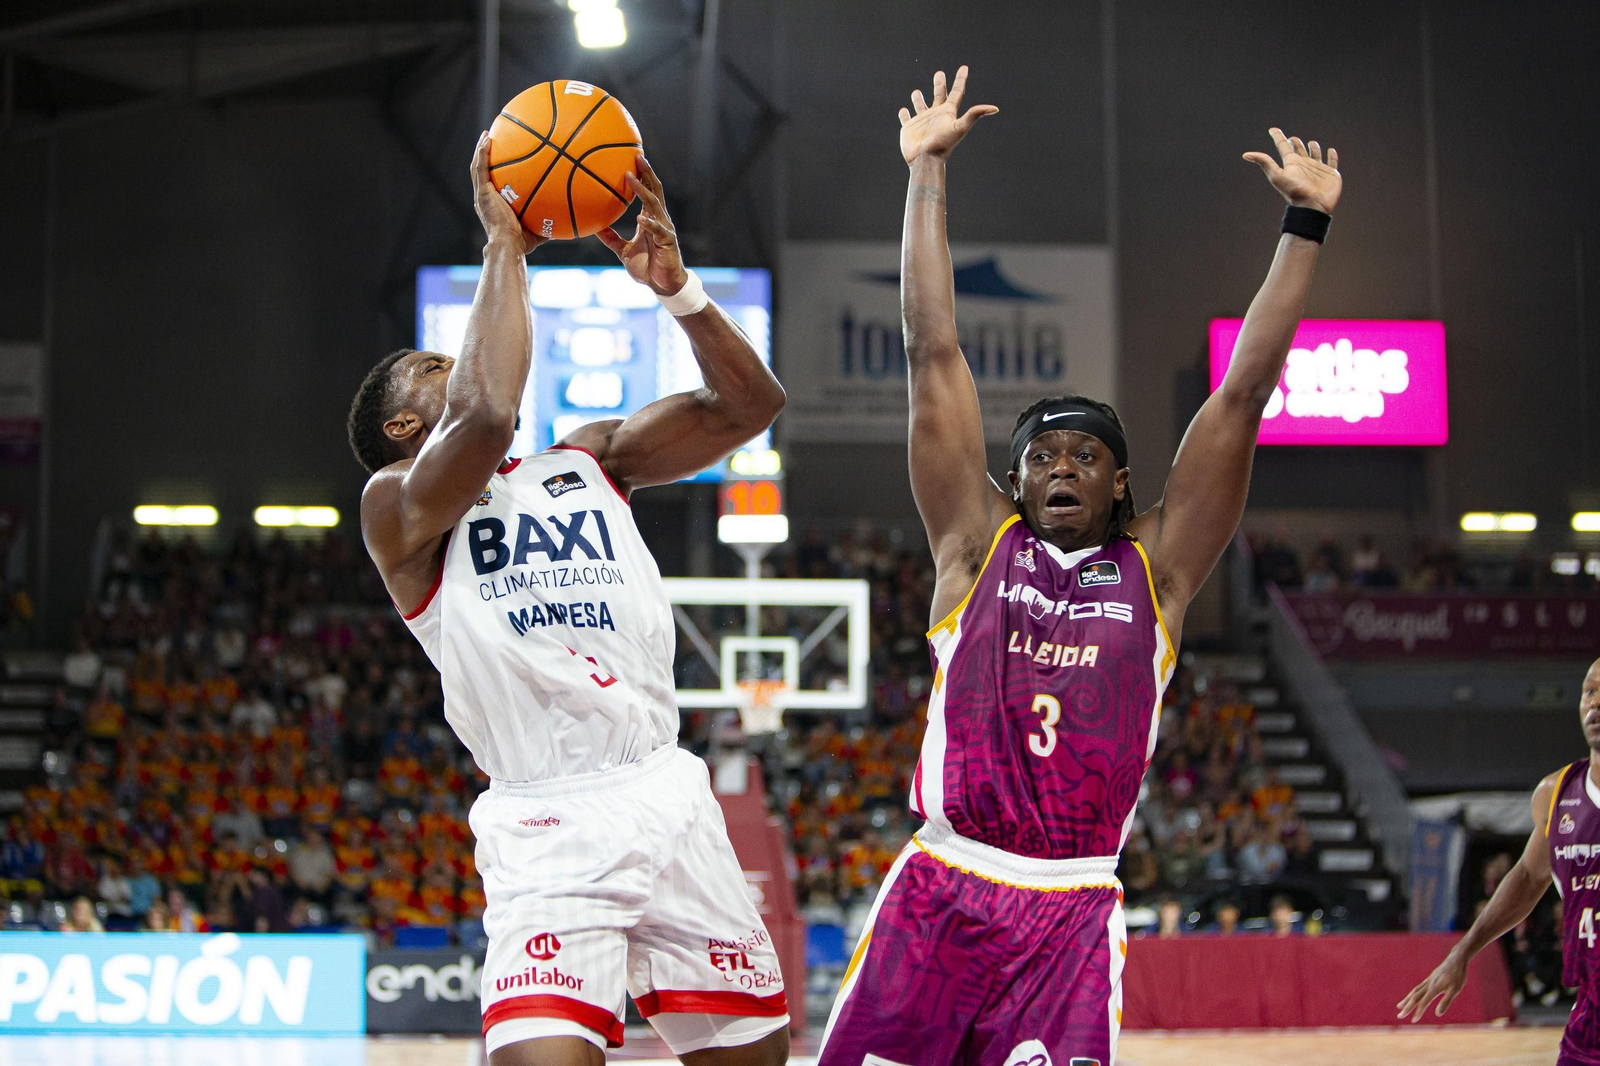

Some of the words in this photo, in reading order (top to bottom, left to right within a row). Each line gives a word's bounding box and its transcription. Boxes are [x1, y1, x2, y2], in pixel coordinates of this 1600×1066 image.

[552, 481, 584, 496] endesa
[726, 480, 782, 516] 10
[466, 509, 616, 576] BAXI
[479, 563, 625, 602] CLIMATIZACIÓN
[1083, 575, 1117, 584] endesa
[1008, 631, 1100, 668] LLEIDA
[1028, 693, 1061, 757] 3
[0, 933, 314, 1026] PASIÓN
[496, 966, 584, 992] unilabor
[709, 951, 756, 973] ETL
